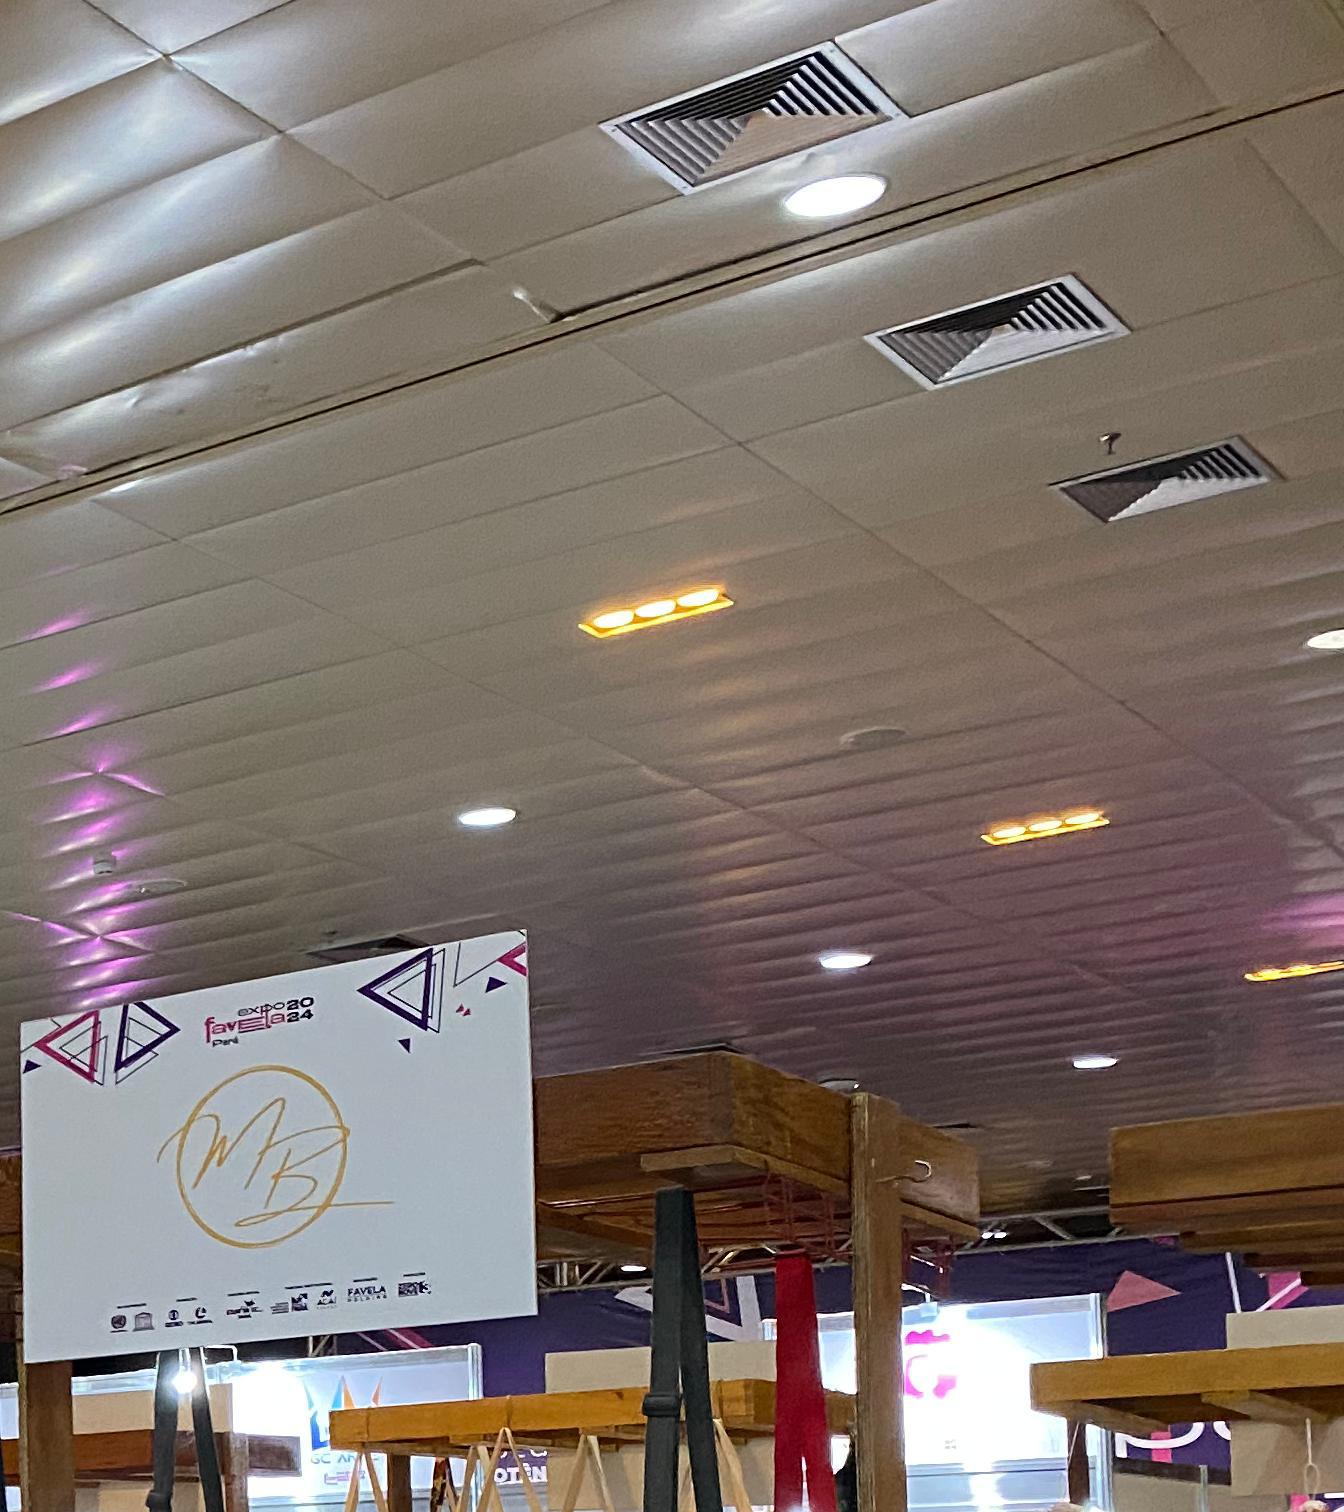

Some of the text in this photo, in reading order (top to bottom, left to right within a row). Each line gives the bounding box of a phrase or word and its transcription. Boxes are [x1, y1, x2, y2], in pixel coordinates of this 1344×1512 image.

[286, 996, 315, 1010] 20
[286, 1009, 314, 1023] 24
[347, 1285, 386, 1296] FAVELA
